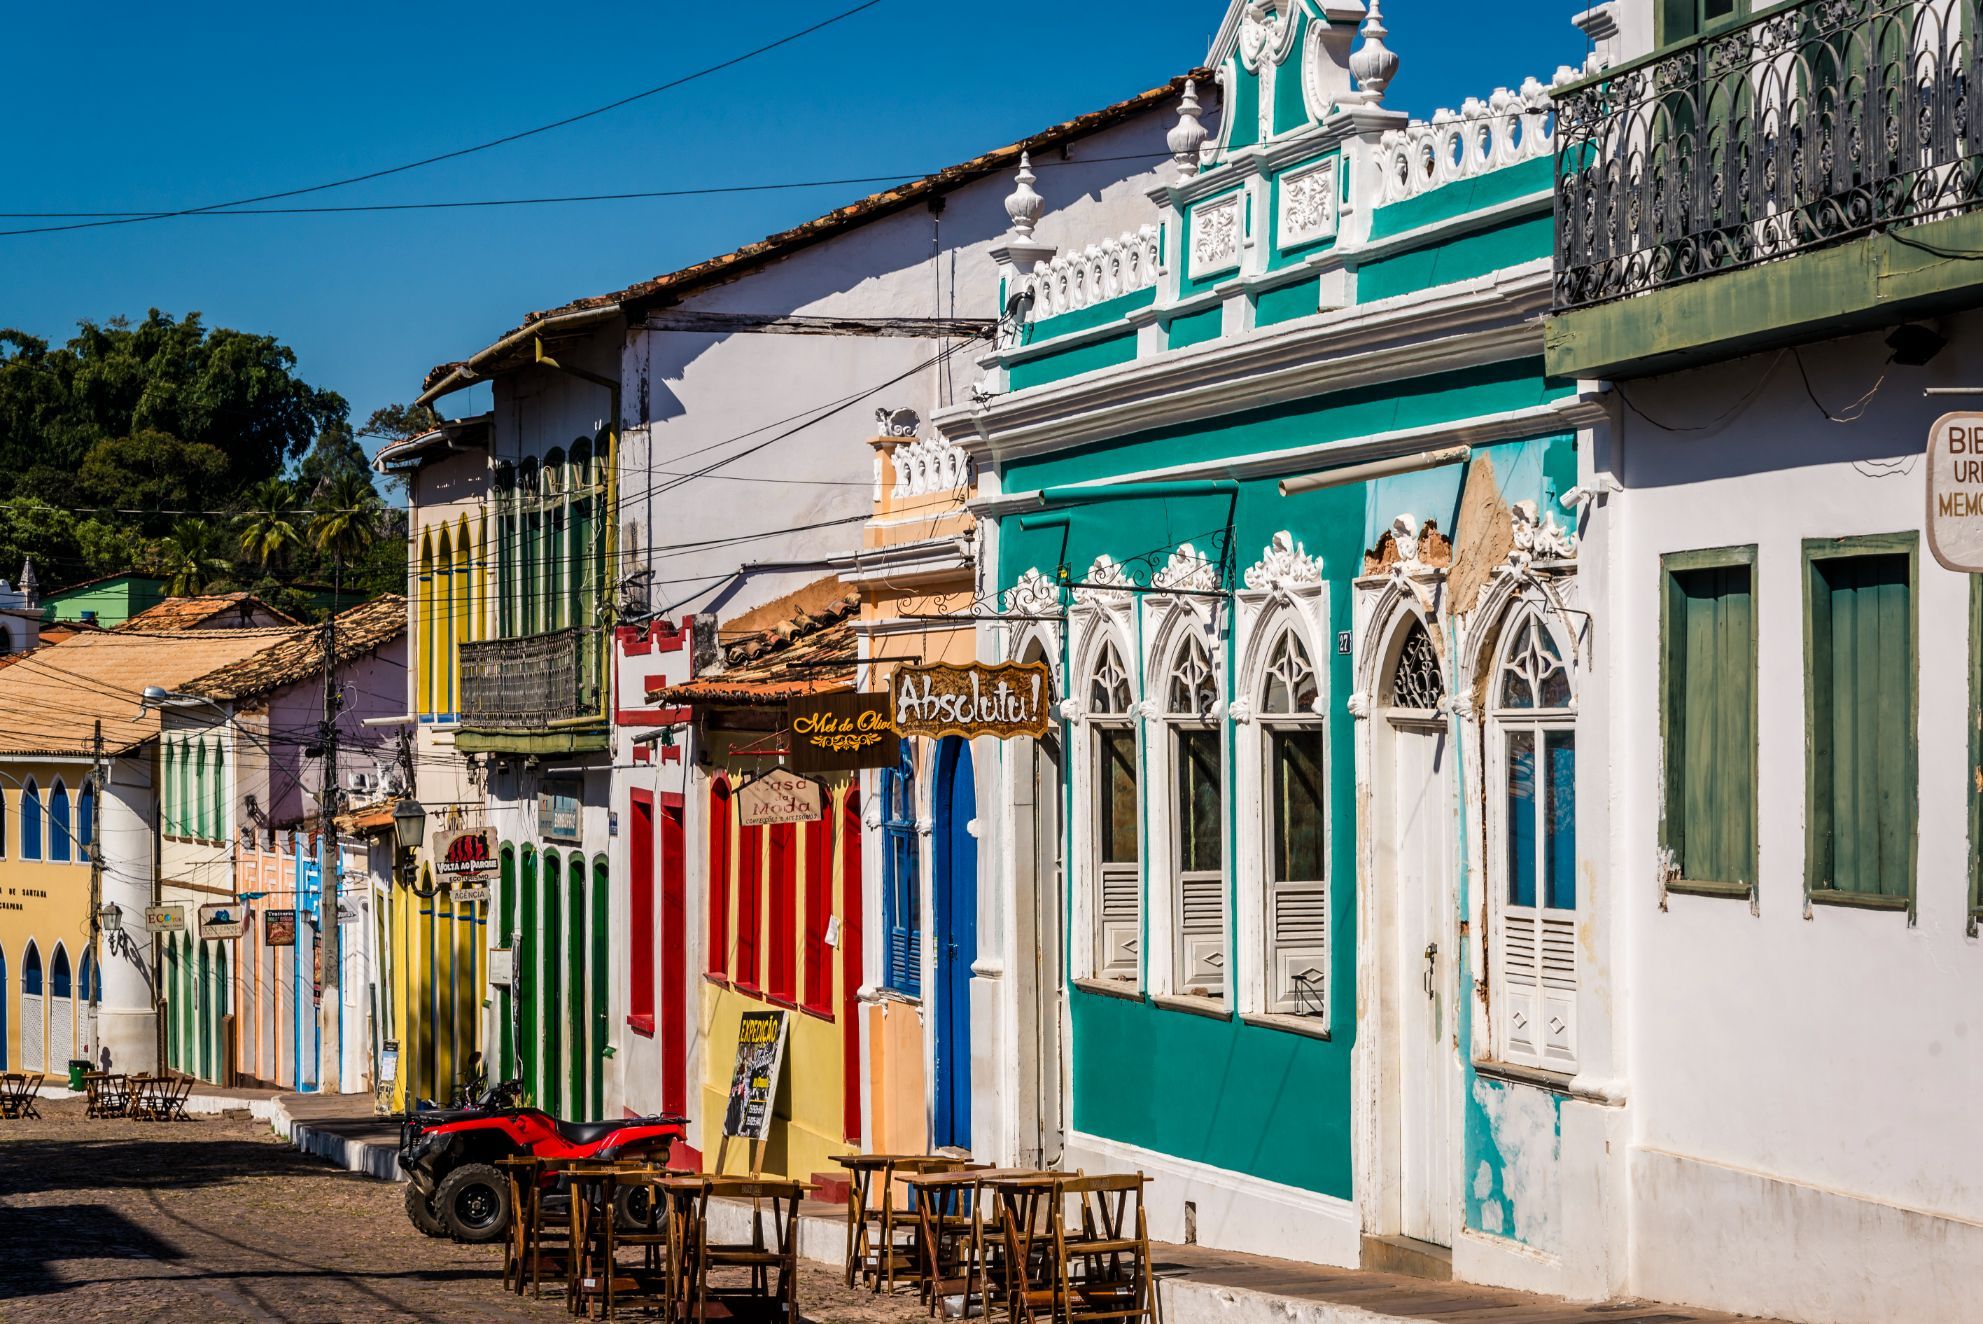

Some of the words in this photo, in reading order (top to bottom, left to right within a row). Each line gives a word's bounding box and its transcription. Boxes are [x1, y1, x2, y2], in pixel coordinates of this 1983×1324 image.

[1340, 634, 1348, 652] 27
[896, 670, 1042, 723] Absolutu!
[794, 712, 837, 733] Mel
[838, 718, 854, 732] de
[753, 796, 811, 815] Moda
[436, 862, 460, 874] VOLTA
[461, 861, 470, 870] AO
[470, 859, 497, 871] PARQUE
